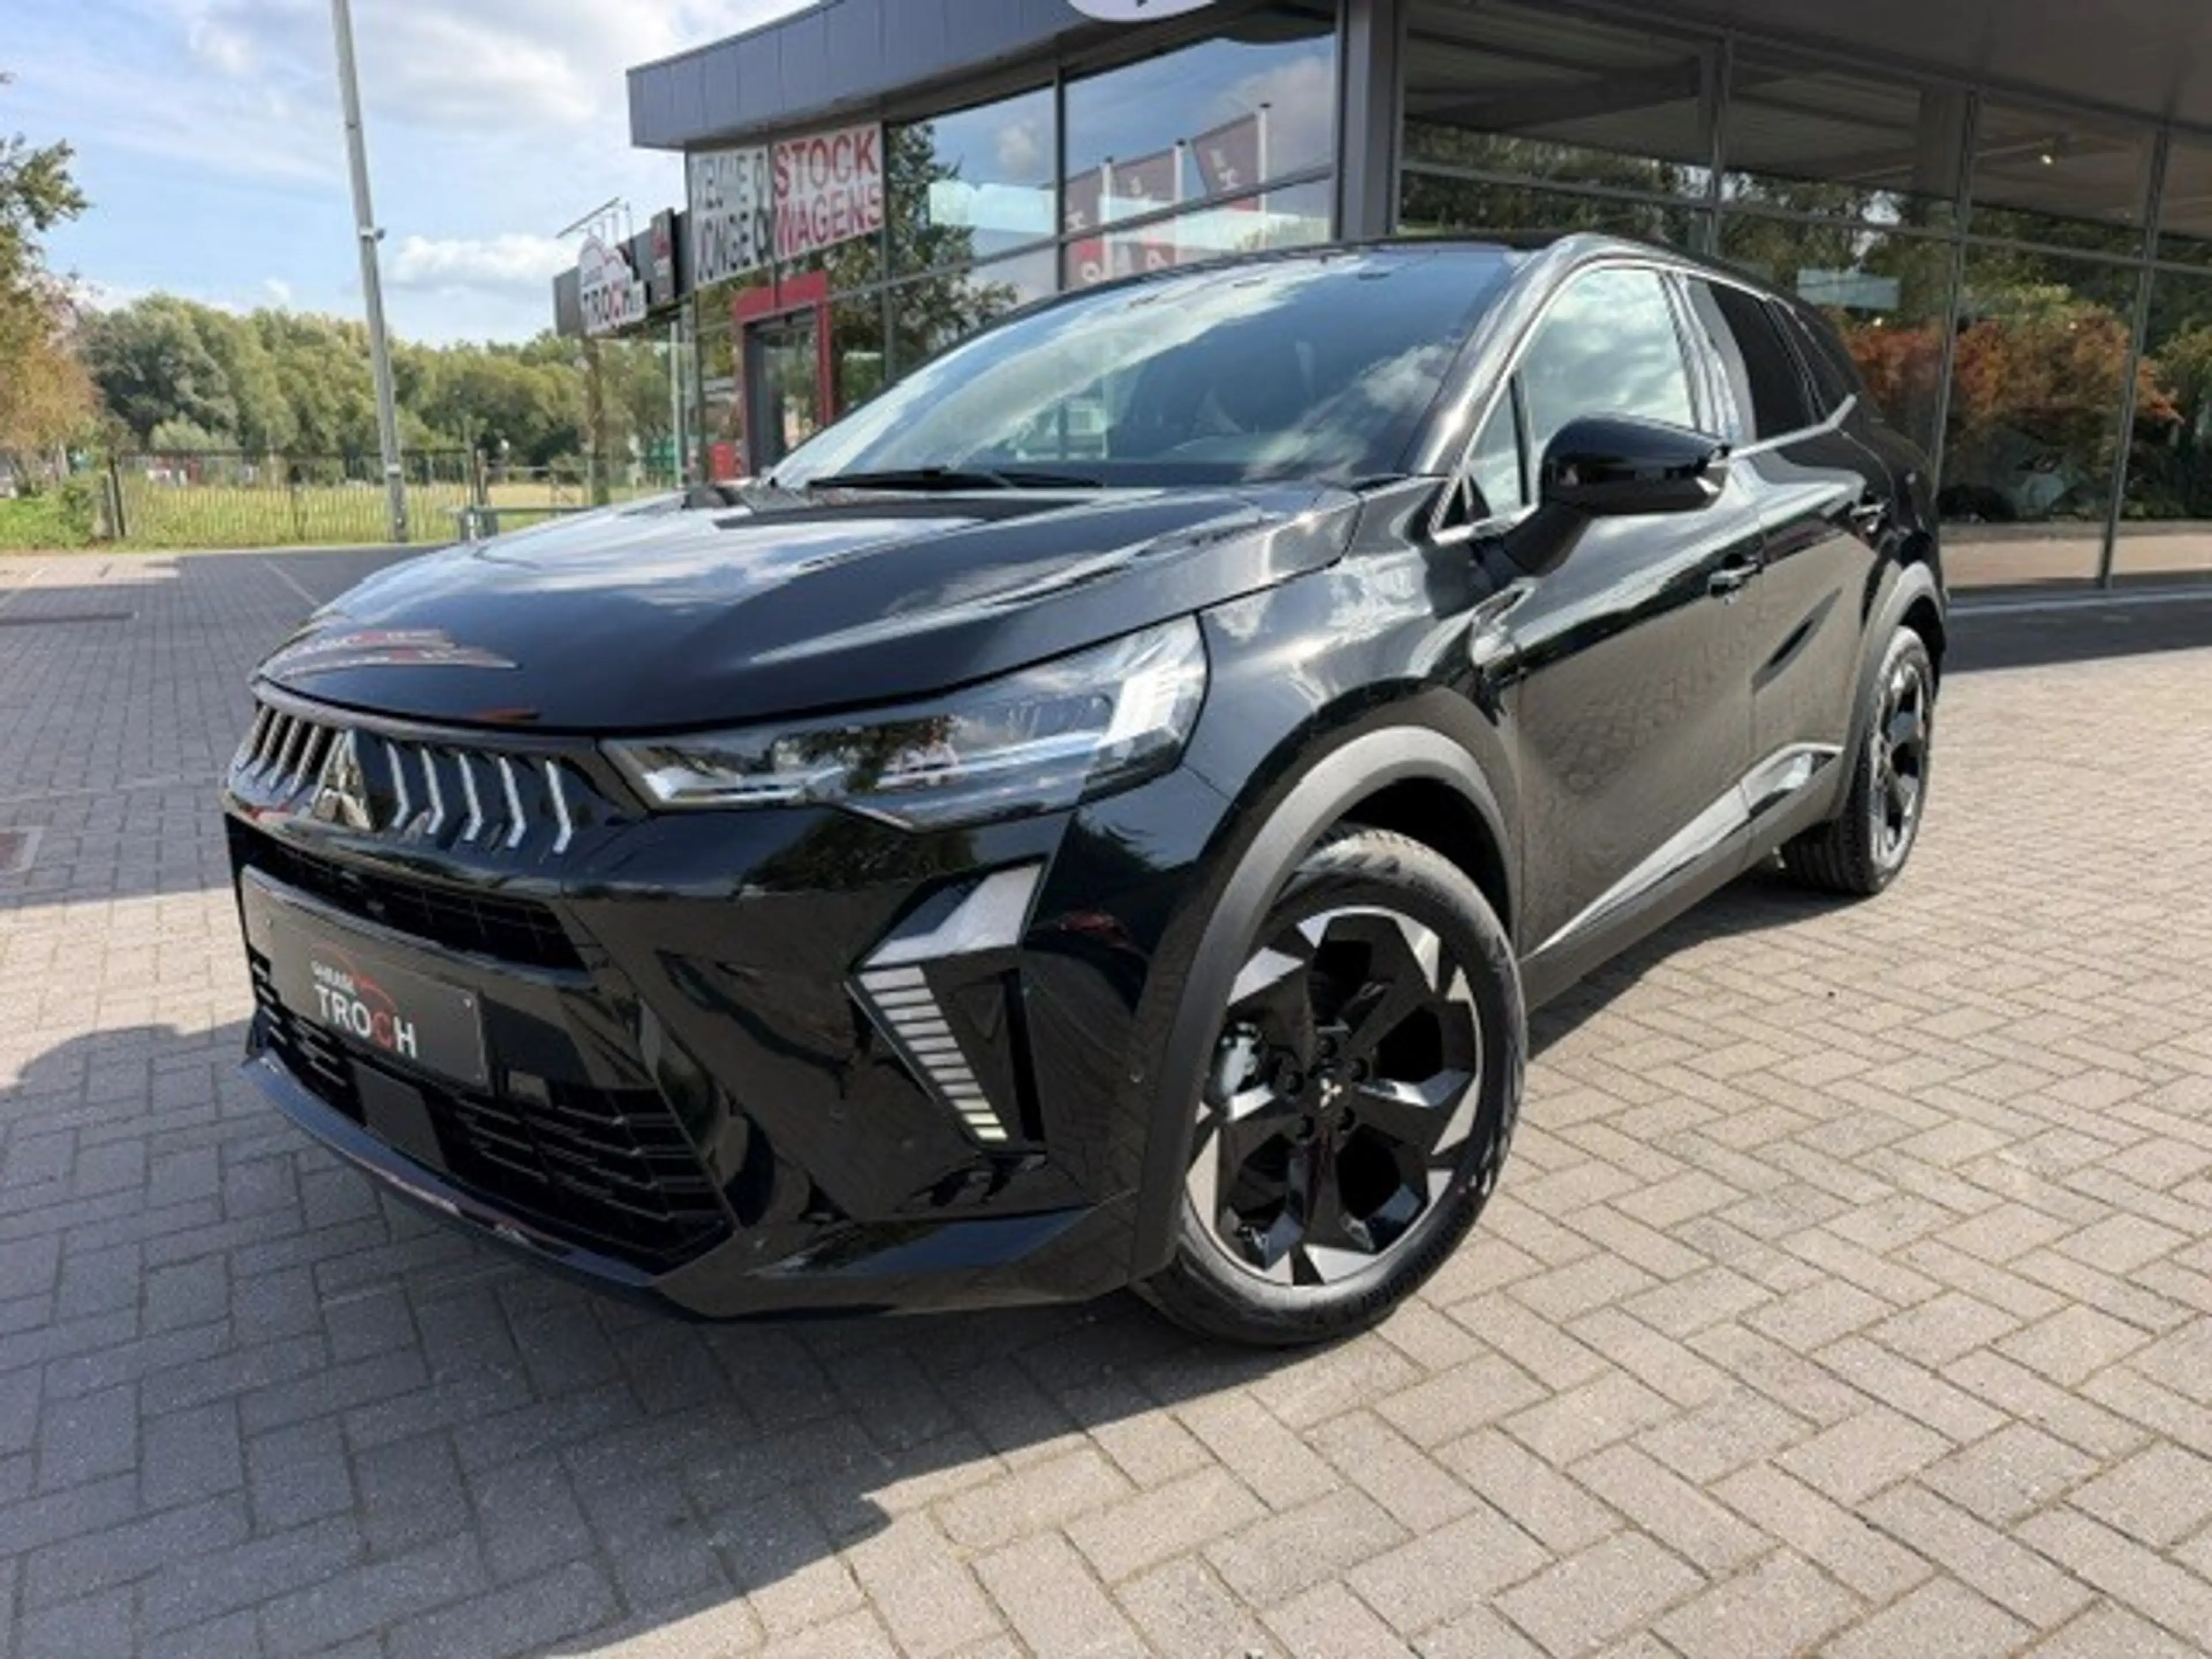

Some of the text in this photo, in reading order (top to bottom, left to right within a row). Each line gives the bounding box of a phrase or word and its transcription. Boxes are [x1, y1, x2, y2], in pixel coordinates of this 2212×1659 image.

[774, 130, 881, 198] STOCK
[775, 183, 882, 257] WAGENS
[314, 984, 417, 1059] TROCH
